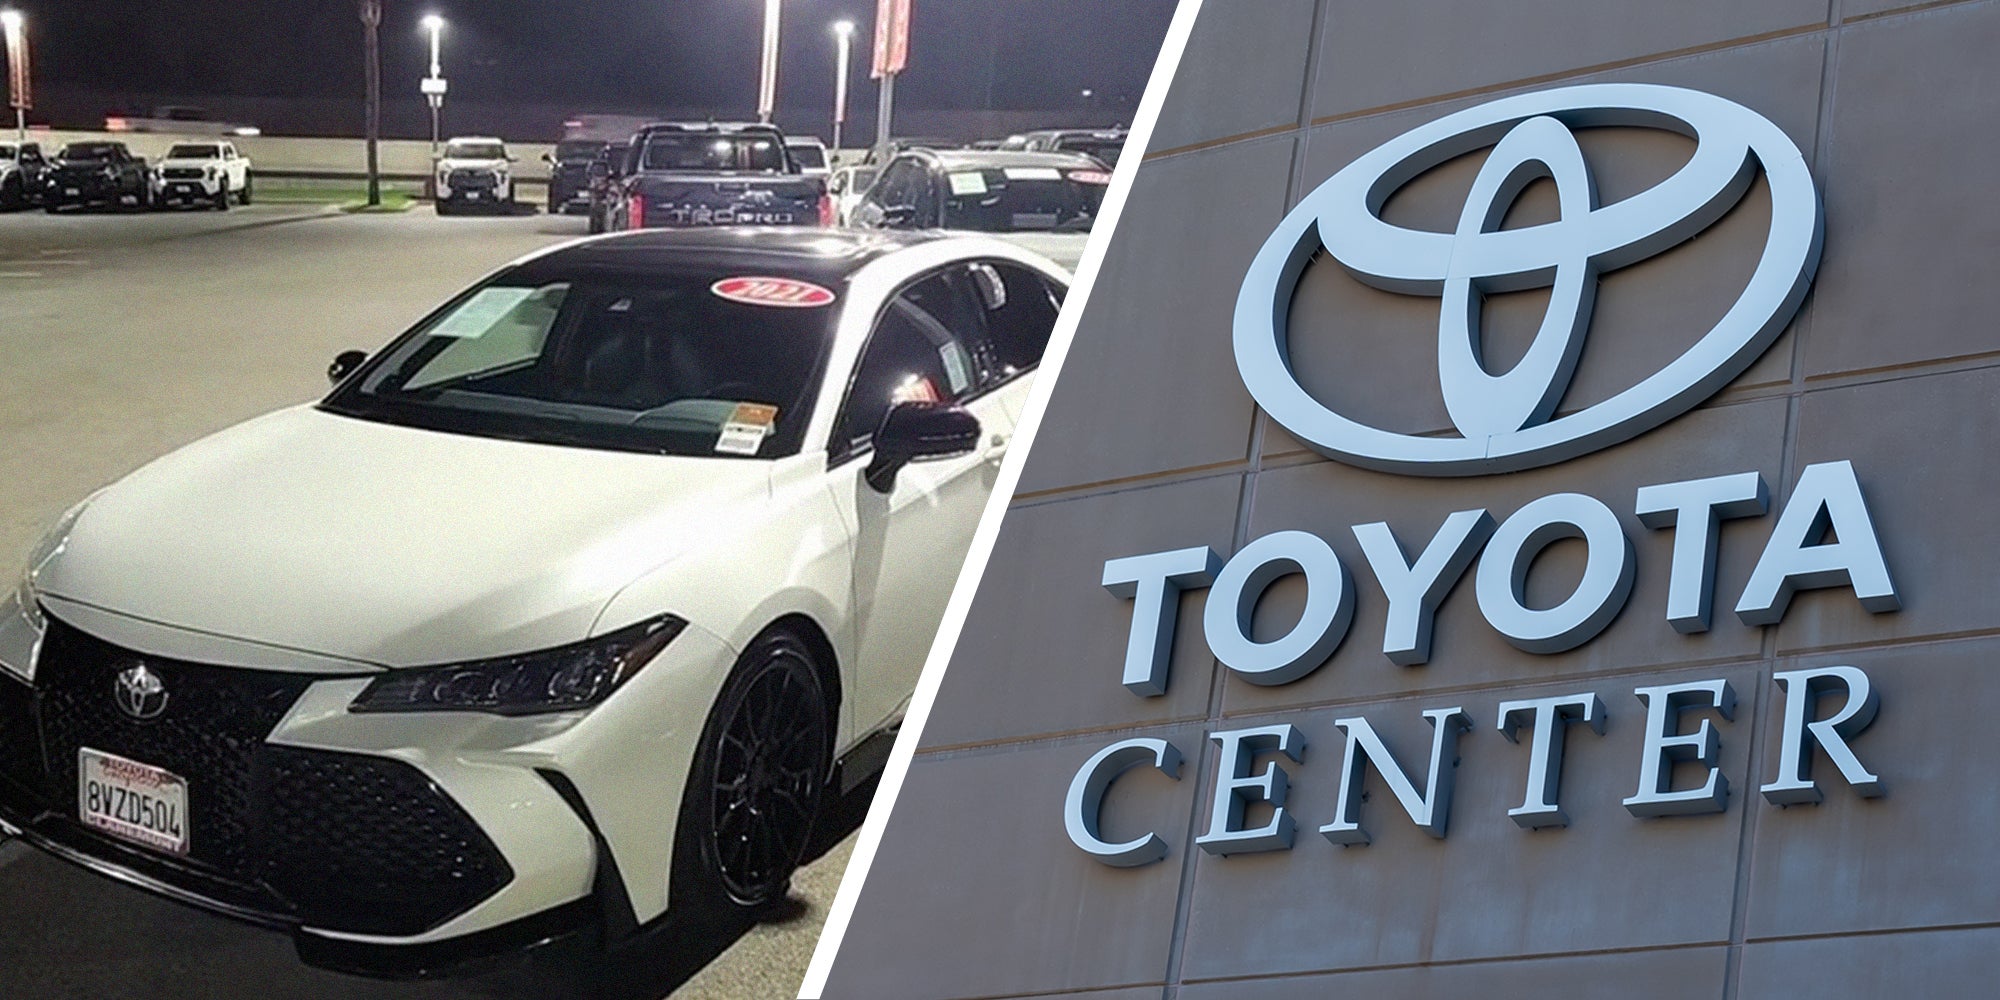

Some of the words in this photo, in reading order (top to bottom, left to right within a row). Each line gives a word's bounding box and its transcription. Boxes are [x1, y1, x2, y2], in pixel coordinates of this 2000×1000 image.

[1101, 460, 1902, 698] TOYOTA
[88, 780, 180, 838] 8VZD504
[1063, 666, 1886, 868] CENTER
